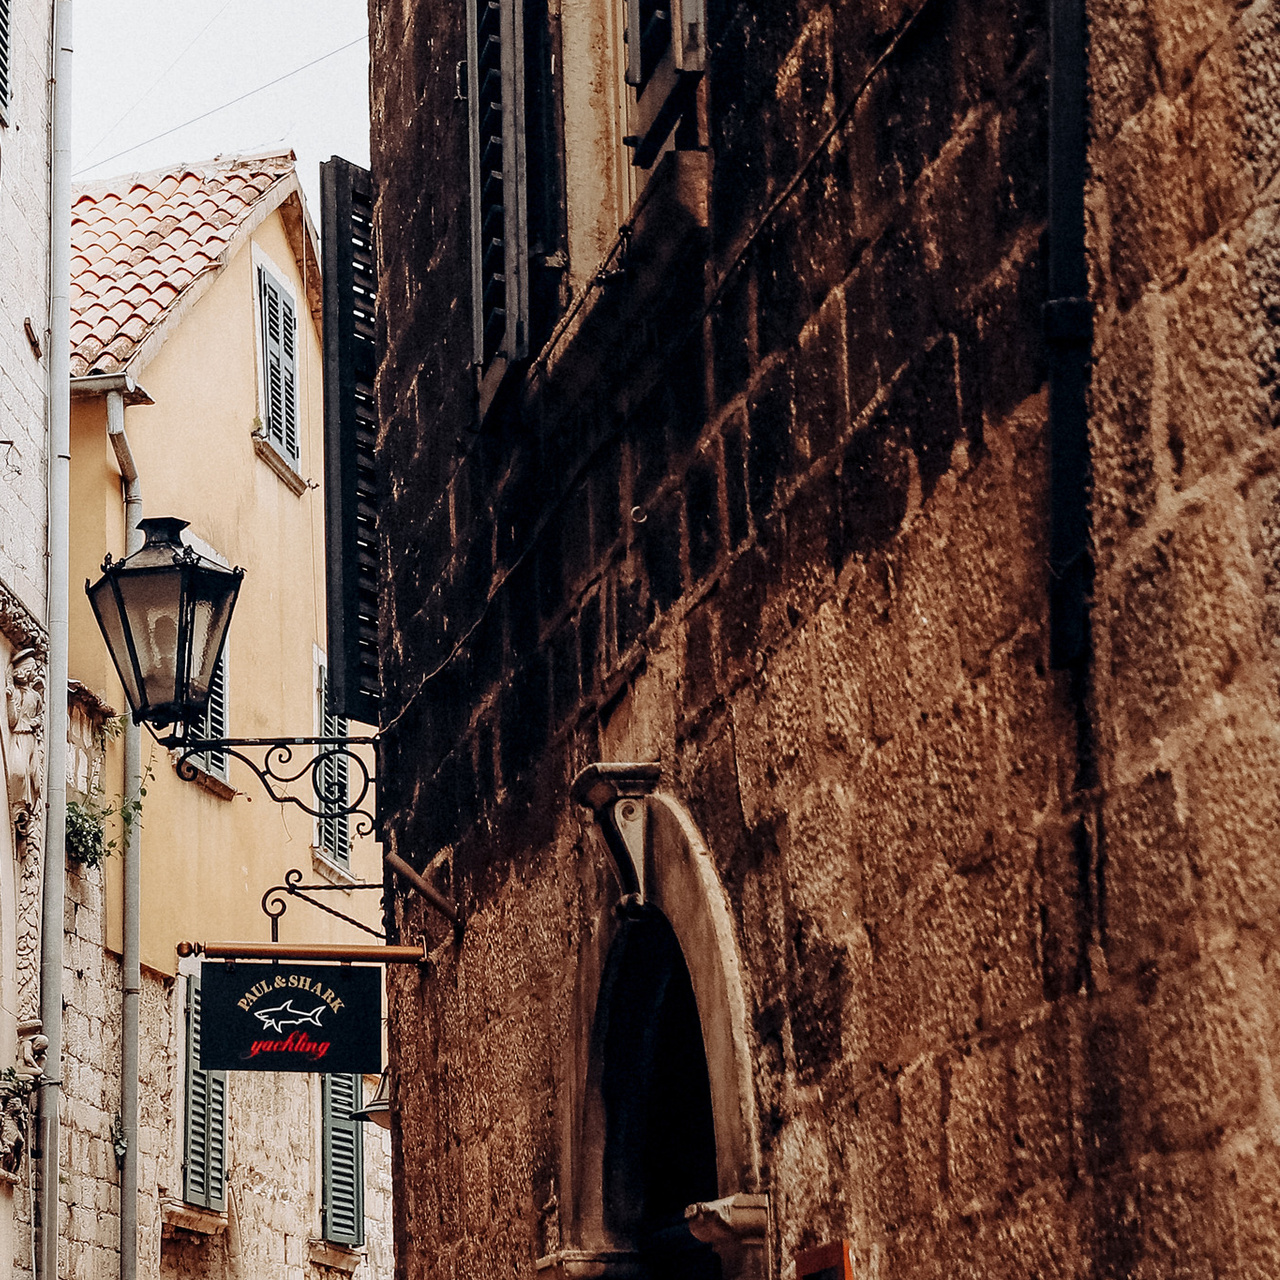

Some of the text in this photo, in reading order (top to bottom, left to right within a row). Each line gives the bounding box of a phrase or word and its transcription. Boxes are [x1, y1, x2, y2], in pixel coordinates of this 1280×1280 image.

[236, 974, 346, 1014] PAUL & SHARK
[239, 1029, 331, 1061] yachting
